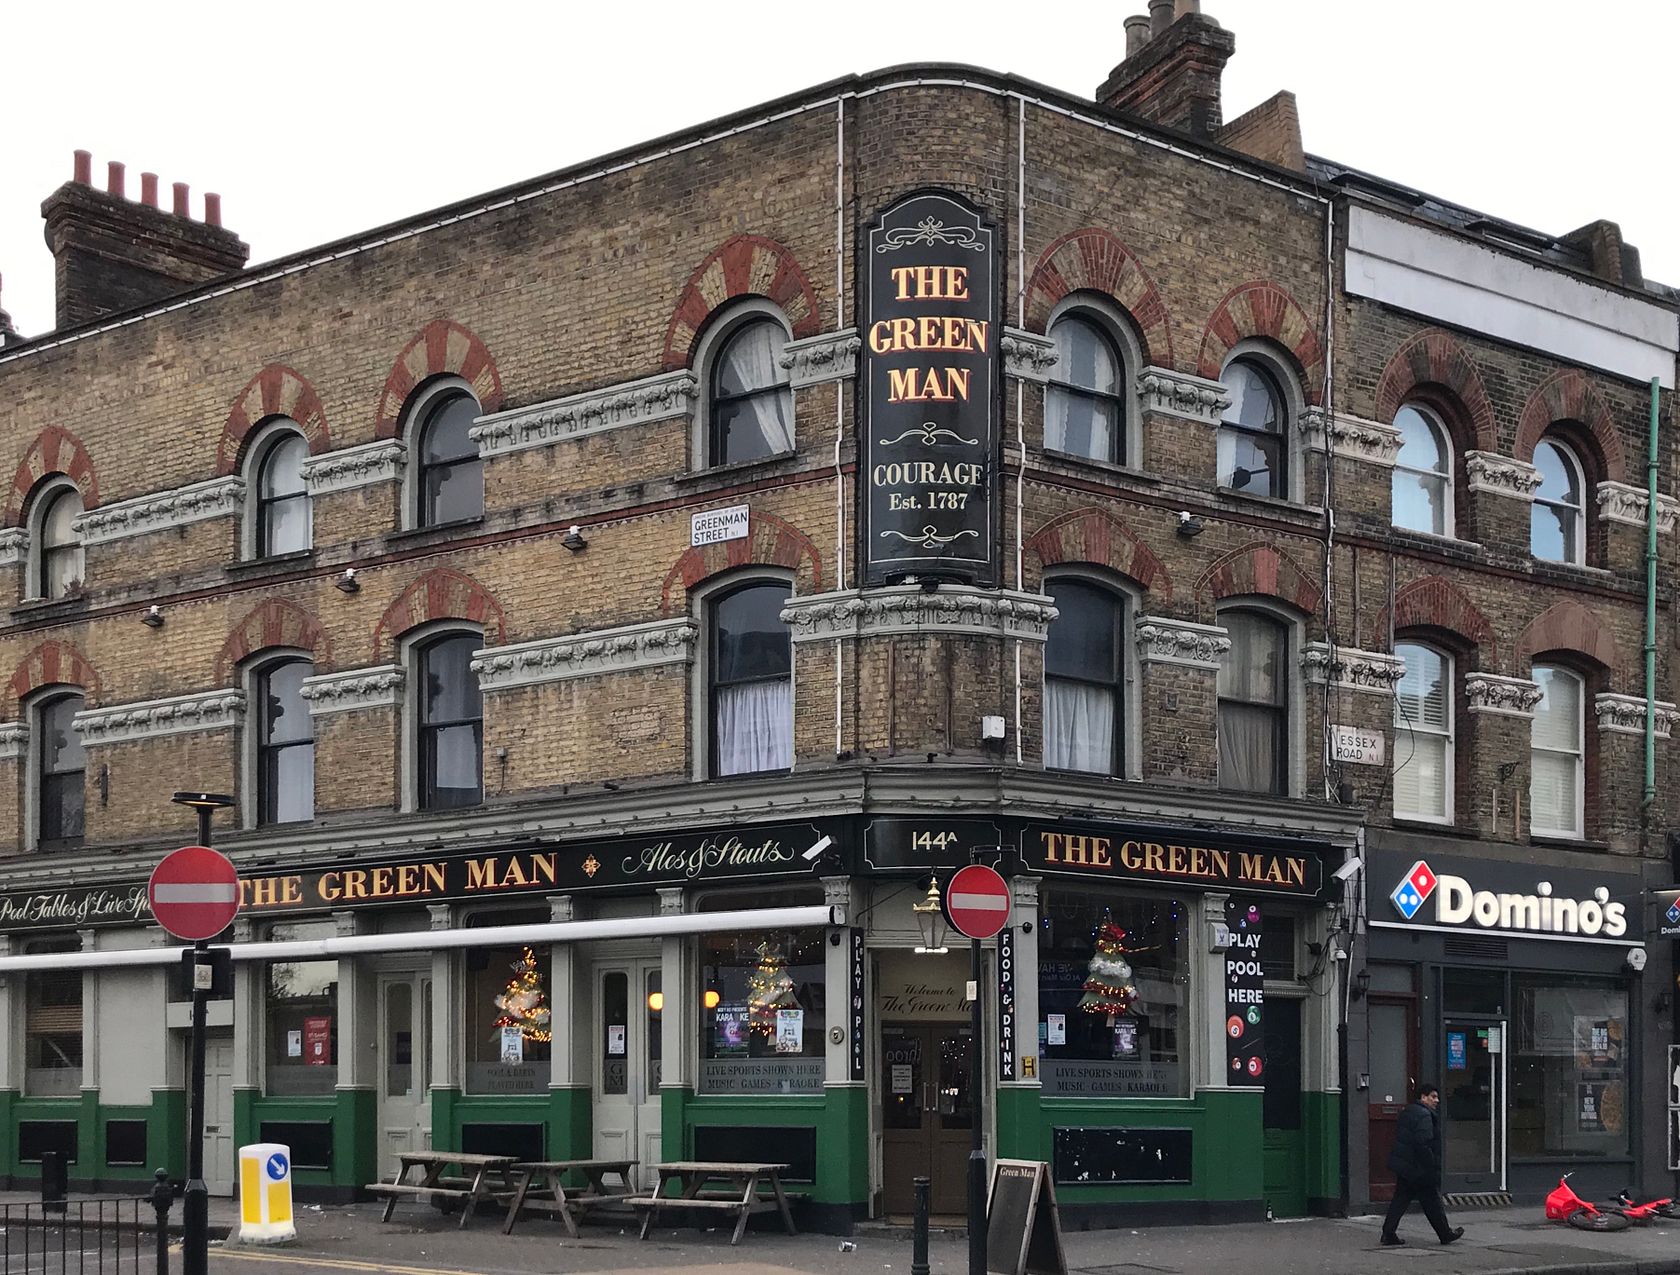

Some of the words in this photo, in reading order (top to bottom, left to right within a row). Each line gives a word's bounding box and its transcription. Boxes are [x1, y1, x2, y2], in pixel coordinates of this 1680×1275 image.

[892, 266, 969, 301] THE
[869, 317, 989, 353] GREEN
[888, 367, 969, 402] MAN
[873, 462, 984, 488] COURAGE
[889, 493, 922, 511] Est.
[928, 492, 968, 510] 1787
[695, 511, 748, 531] GREENMAN
[694, 527, 729, 544] STREET
[1341, 735, 1377, 749] ESSEX
[1337, 747, 1363, 760] ROAD
[913, 831, 958, 850] 144A
[622, 842, 685, 874] Ales
[704, 834, 795, 868] Stouts
[1041, 831, 1112, 867] THE
[1120, 840, 1230, 878] GREEN
[1238, 852, 1306, 886] MAN
[239, 875, 303, 908] THE
[317, 862, 448, 901] GREEN
[464, 853, 558, 890] MAN
[1436, 874, 1627, 936] Domino's
[1229, 933, 1262, 949] PLAY
[1002, 934, 1011, 982] FOOD
[1227, 961, 1264, 976] POOL
[1228, 989, 1263, 1003] HERE
[1003, 1015, 1012, 1076] DRINK
[706, 1065, 727, 1075] LIVE
[728, 1066, 761, 1075] SPORTS
[1056, 1068, 1077, 1077] LIVE
[1078, 1069, 1112, 1078] SPORTS
[1000, 1167, 1019, 1177] Green
[1020, 1168, 1035, 1178] Man
